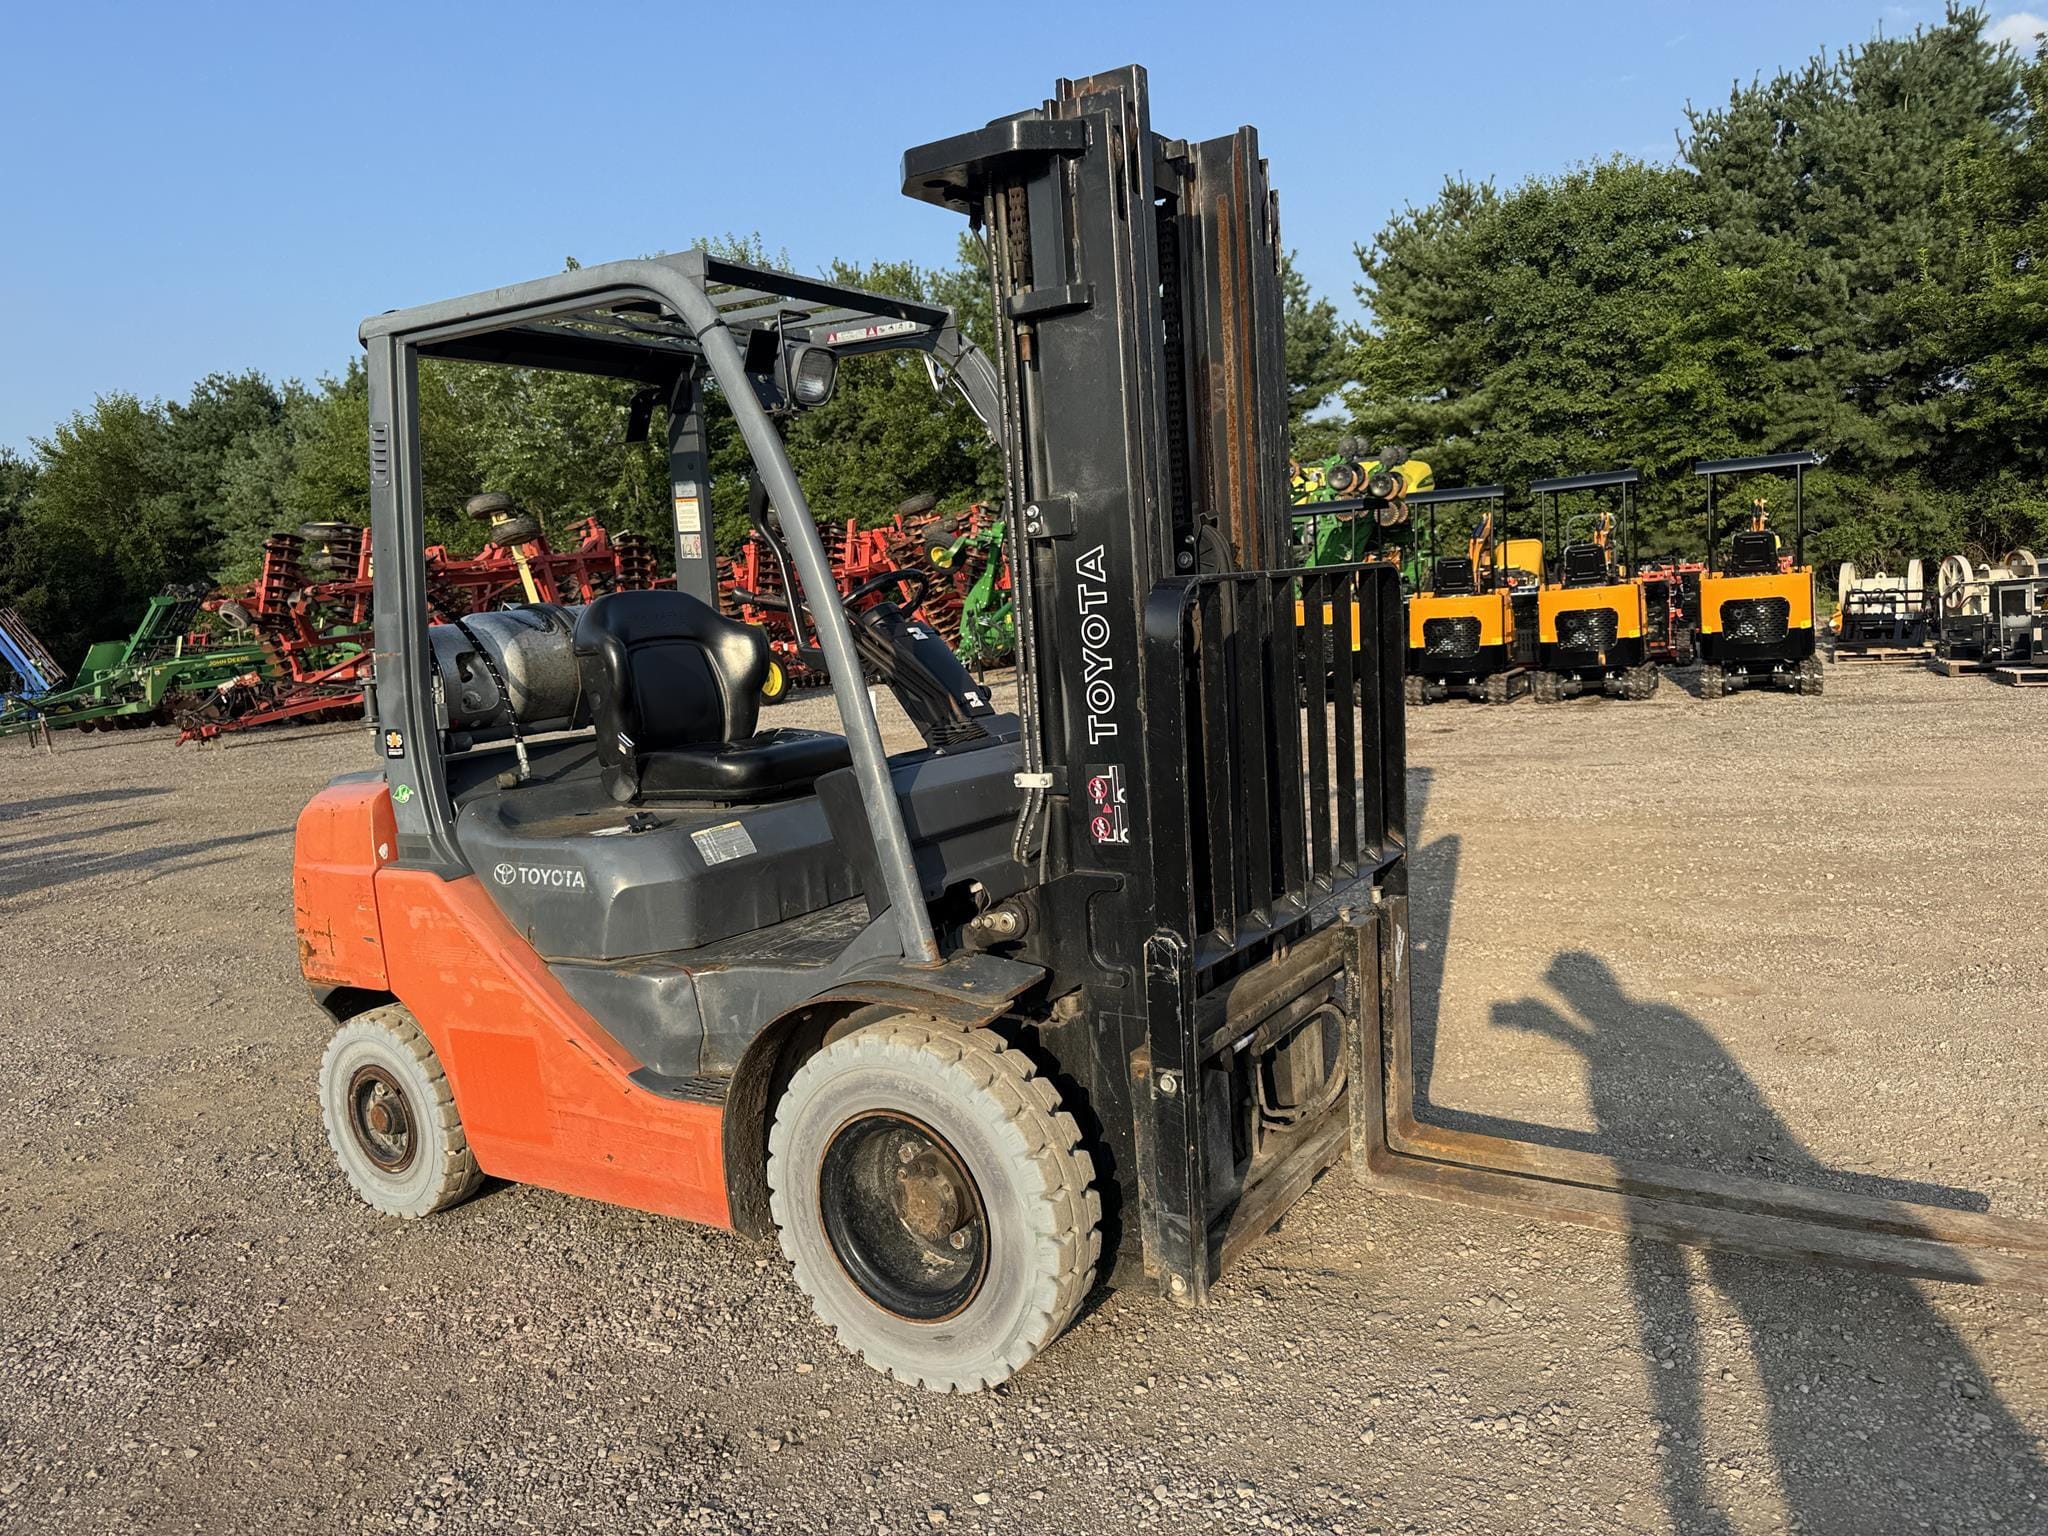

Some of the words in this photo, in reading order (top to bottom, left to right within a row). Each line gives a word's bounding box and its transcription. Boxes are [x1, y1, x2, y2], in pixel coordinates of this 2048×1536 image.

[1075, 544, 1118, 745] TOYOTA
[208, 659, 227, 667] JOHN
[227, 655, 250, 663] DEERE
[518, 867, 585, 888] TOYOTA
